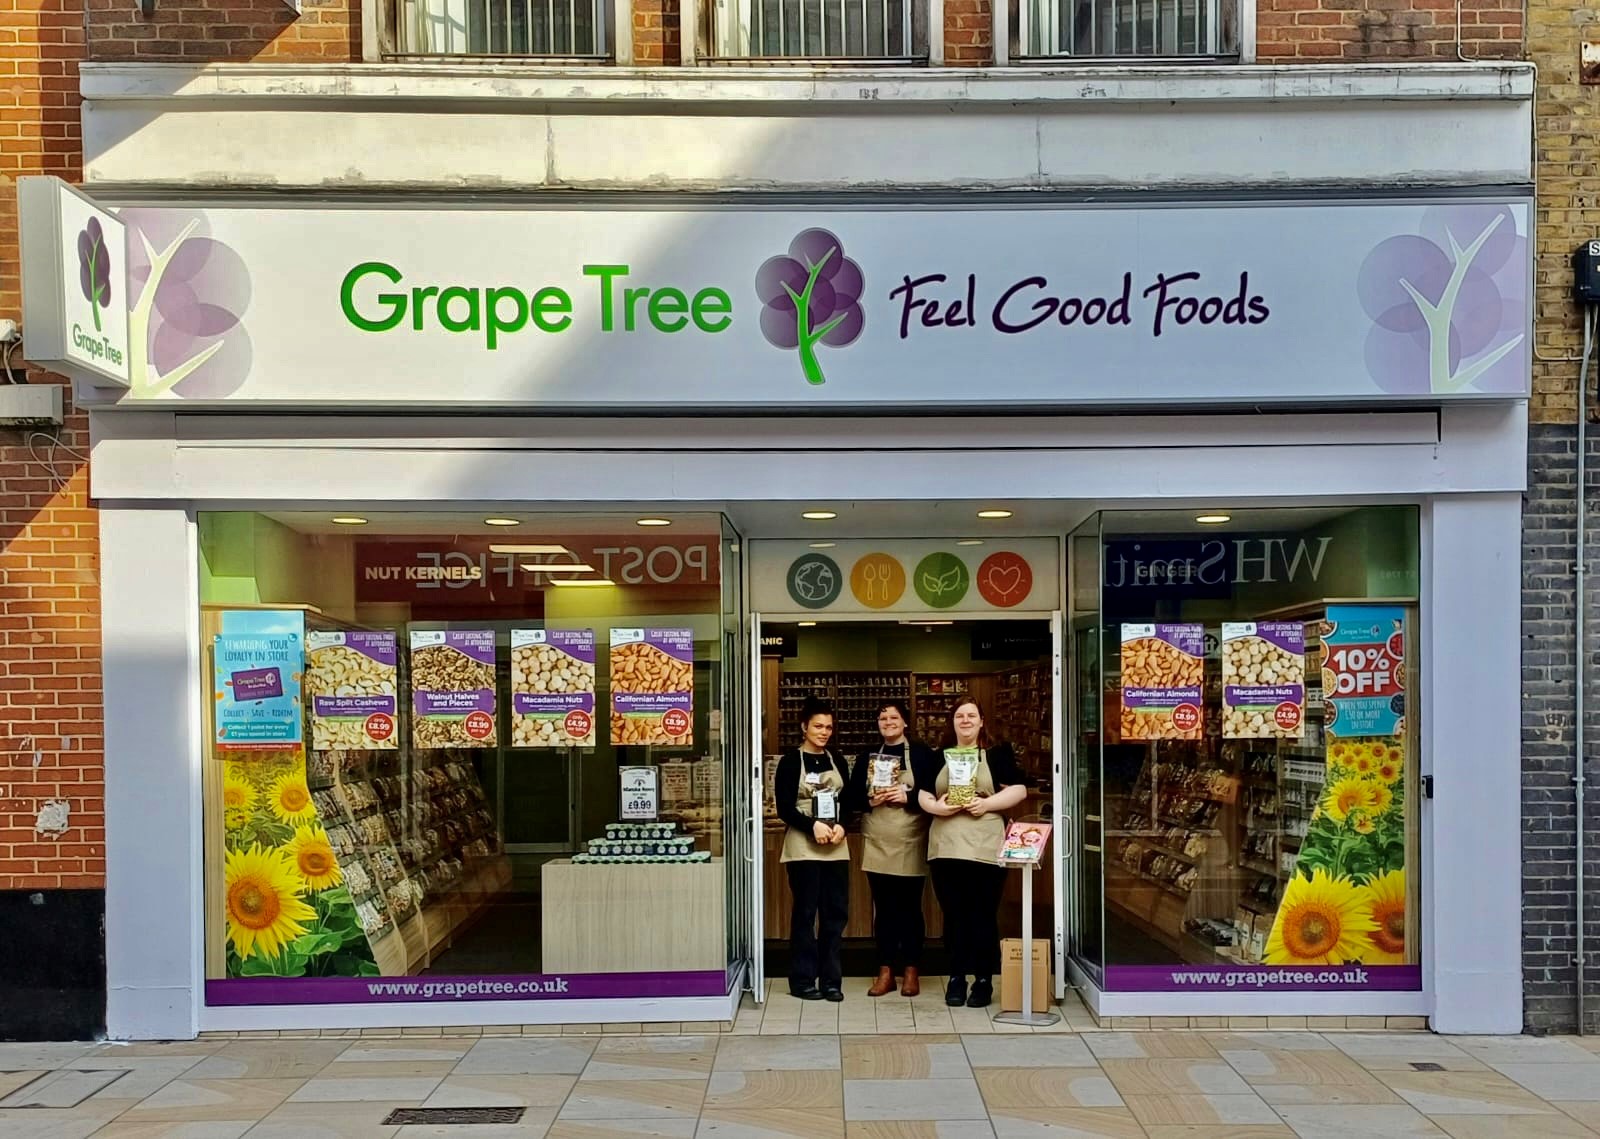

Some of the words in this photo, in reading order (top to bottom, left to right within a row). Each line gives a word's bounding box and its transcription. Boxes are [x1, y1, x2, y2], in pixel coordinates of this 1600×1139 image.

[340, 262, 572, 350] Grape
[582, 264, 732, 332] Tree
[890, 274, 976, 338] Feel
[991, 272, 1133, 333] Good
[1143, 271, 1270, 337] Foods
[73, 323, 103, 360] Grape
[103, 337, 122, 366] Tree
[365, 566, 400, 580] NUT
[405, 566, 482, 580] KERNELS
[1136, 565, 1201, 578] GINGER
[269, 640, 288, 650] YOUR
[225, 651, 252, 661] LOYALTY
[255, 651, 265, 661] IN
[268, 651, 288, 660] STORE
[1333, 648, 1390, 672] 10%
[1337, 672, 1390, 694] OFF
[1126, 690, 1165, 698] Californian
[1232, 688, 1274, 696] Macadamia
[336, 699, 353, 707] Split
[568, 720, 588, 728] £4.99
[628, 800, 652, 810] £9.99
[1171, 968, 1368, 987] www.grapetree.co.uk
[367, 977, 568, 997] www.grapetree.co.uk
